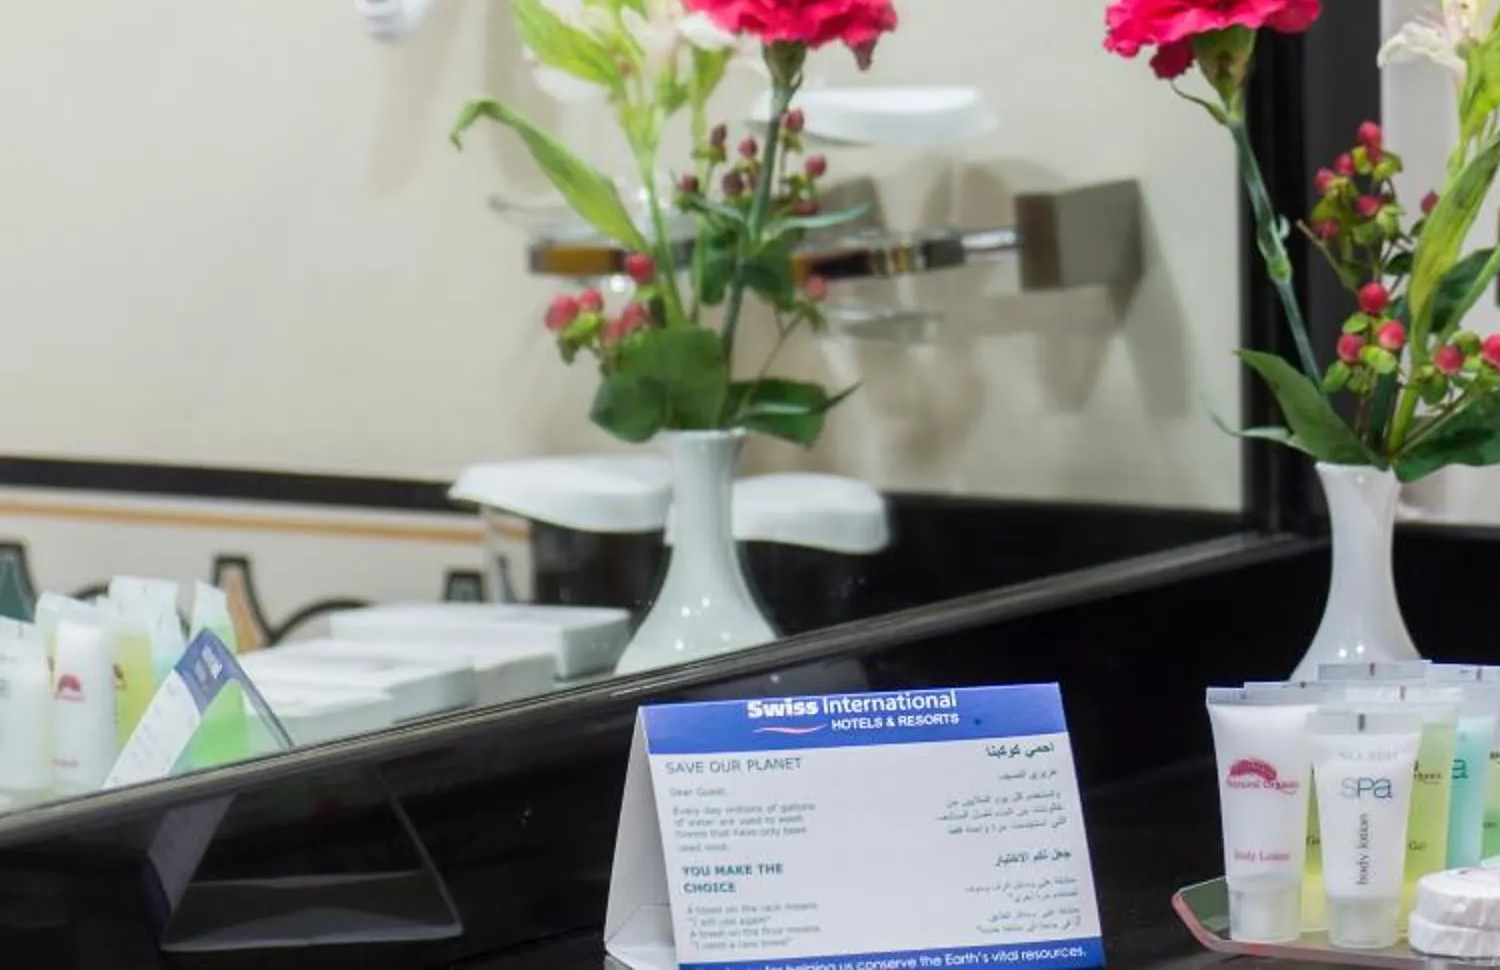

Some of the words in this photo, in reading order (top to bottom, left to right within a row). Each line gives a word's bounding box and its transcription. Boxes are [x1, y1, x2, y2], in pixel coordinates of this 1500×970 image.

[748, 699, 818, 718] Swiss
[823, 690, 957, 715] International
[831, 717, 882, 730] HOTELS
[886, 716, 896, 727] &
[899, 713, 959, 726] RESORTS
[665, 761, 704, 775] SAVE
[709, 759, 742, 773] OUR
[747, 757, 802, 772] PLANET
[1355, 812, 1370, 849] lotion
[682, 865, 710, 877] YOU
[715, 864, 753, 875] MAKE
[757, 863, 784, 875] THE
[1355, 853, 1370, 885] body
[683, 882, 736, 894] CHOICE
[856, 958, 917, 970] conserve
[920, 954, 942, 967] the
[945, 951, 989, 966] Earth's
[991, 949, 1019, 963] vital
[1021, 945, 1088, 961] resources.
